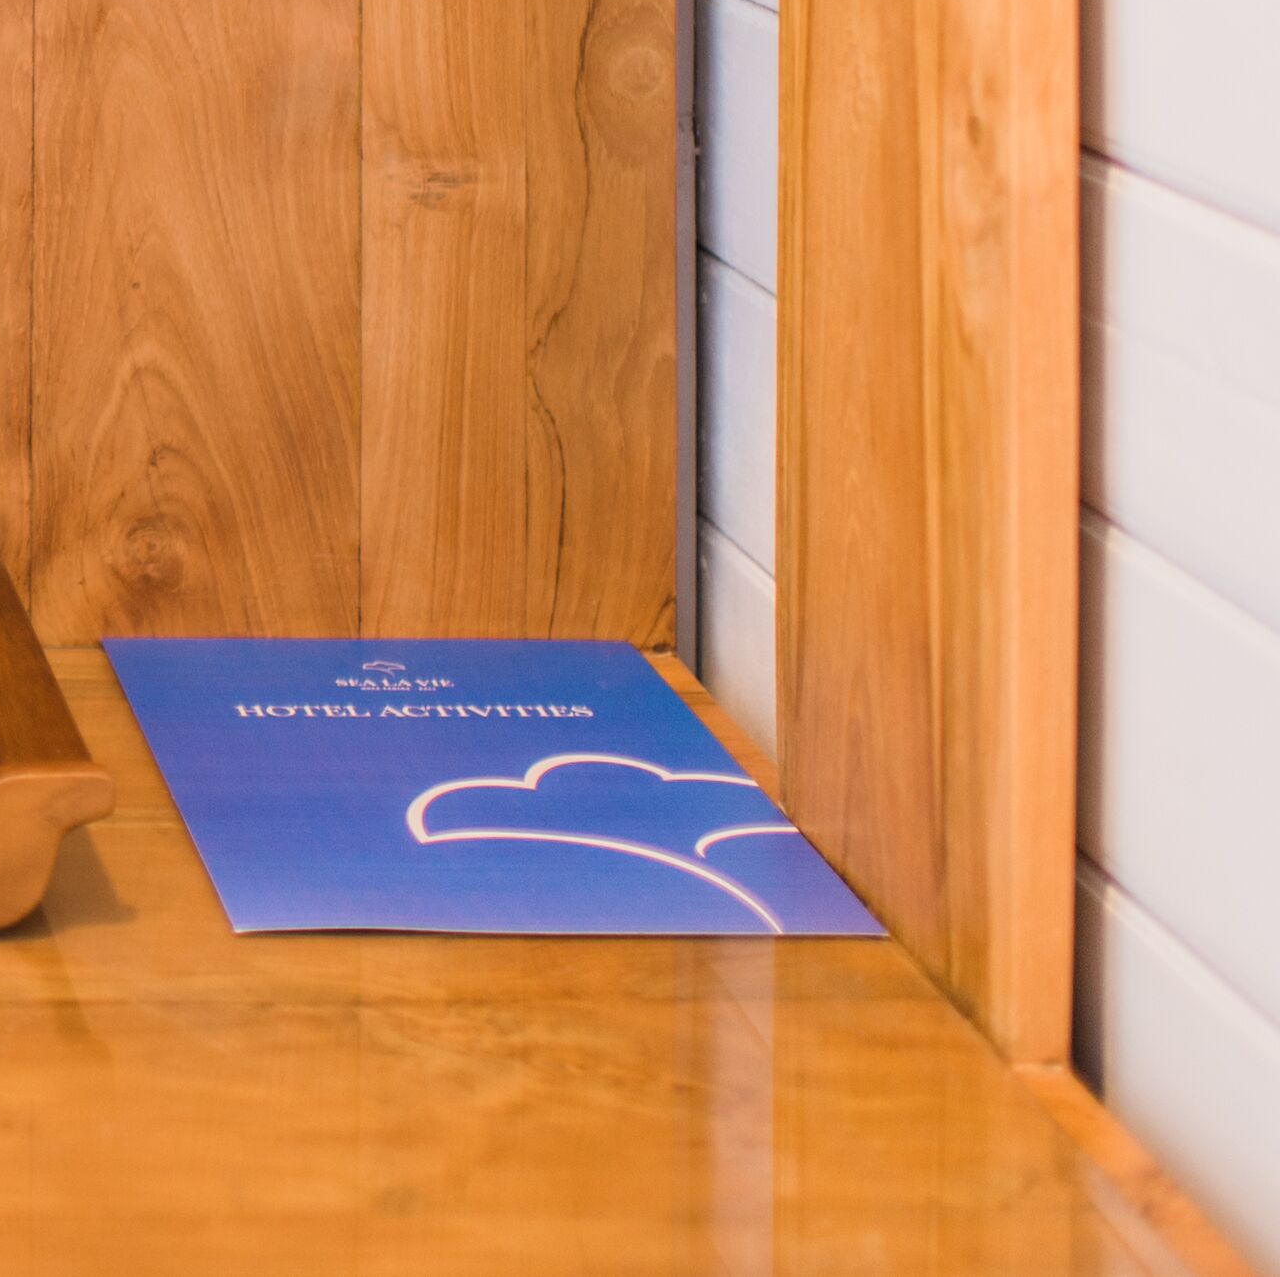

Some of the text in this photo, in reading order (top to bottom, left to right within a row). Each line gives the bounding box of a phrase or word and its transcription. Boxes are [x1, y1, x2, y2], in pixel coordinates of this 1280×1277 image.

[335, 678, 377, 688] SEA
[381, 678, 413, 688] LA
[235, 704, 594, 718] HOTEL ACTIVITIES
